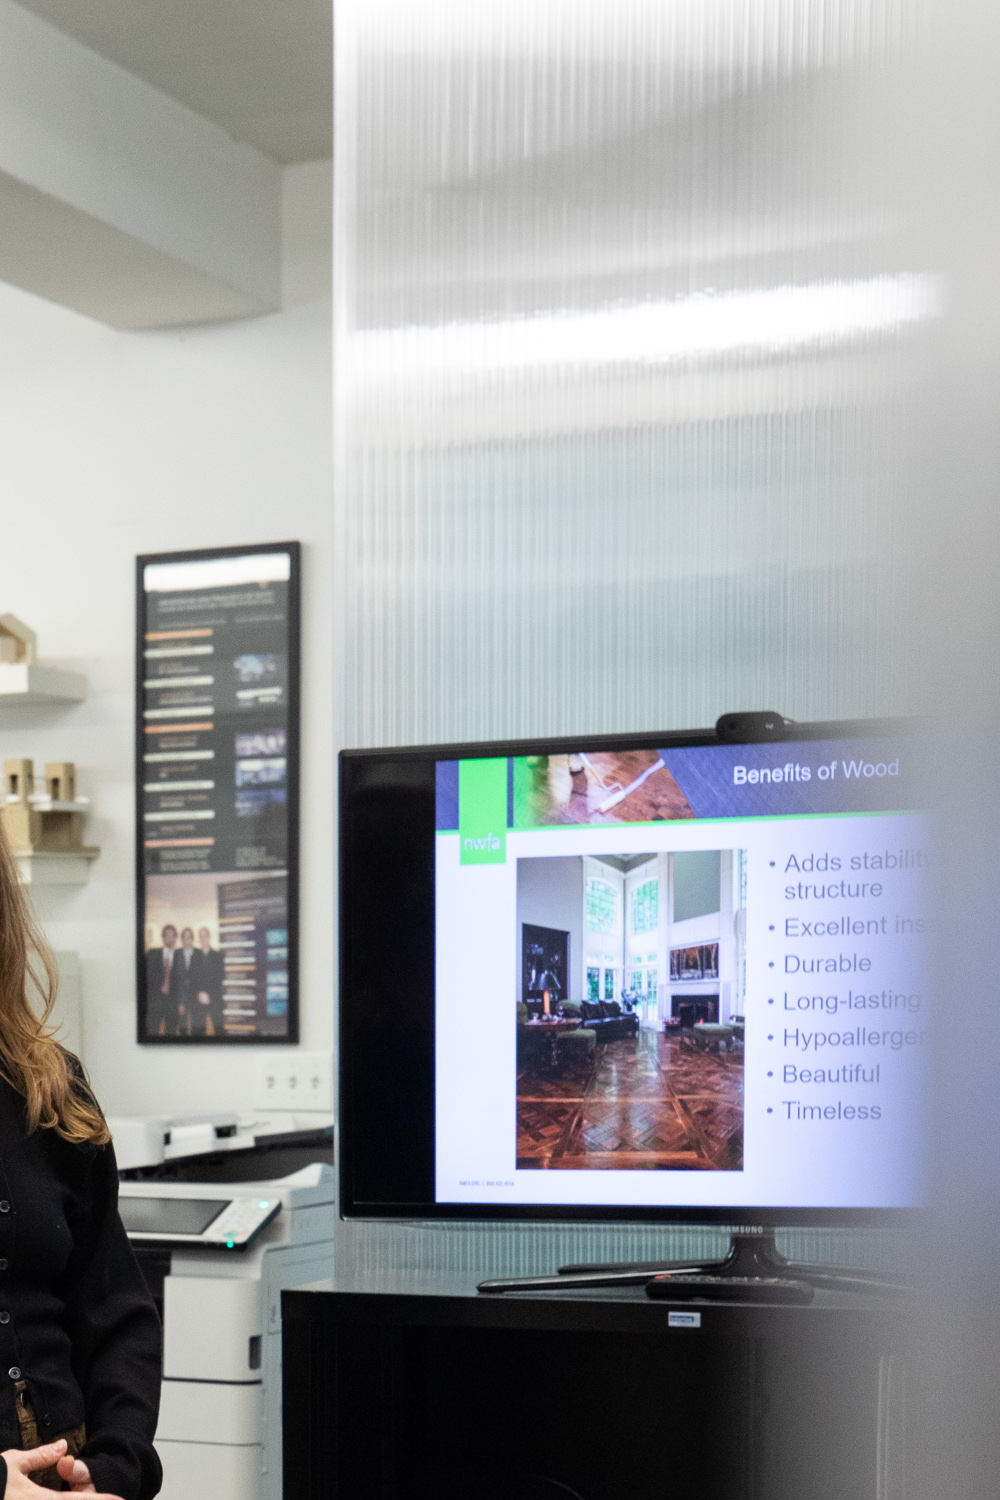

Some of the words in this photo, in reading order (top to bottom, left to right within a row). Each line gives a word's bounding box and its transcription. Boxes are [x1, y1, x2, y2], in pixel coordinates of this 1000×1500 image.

[733, 763, 812, 785] Benefits
[818, 761, 838, 780] of
[841, 759, 900, 780] Wood
[463, 832, 502, 853] nwfa
[784, 853, 842, 873] Adds
[784, 880, 883, 900] structure
[785, 916, 887, 937] Excellent
[785, 954, 872, 974] Durable
[784, 990, 922, 1014] Long-lasting
[783, 1064, 881, 1084] Beautiful
[783, 1101, 882, 1121] Timeless
[720, 1225, 764, 1234] SAMSUNG
